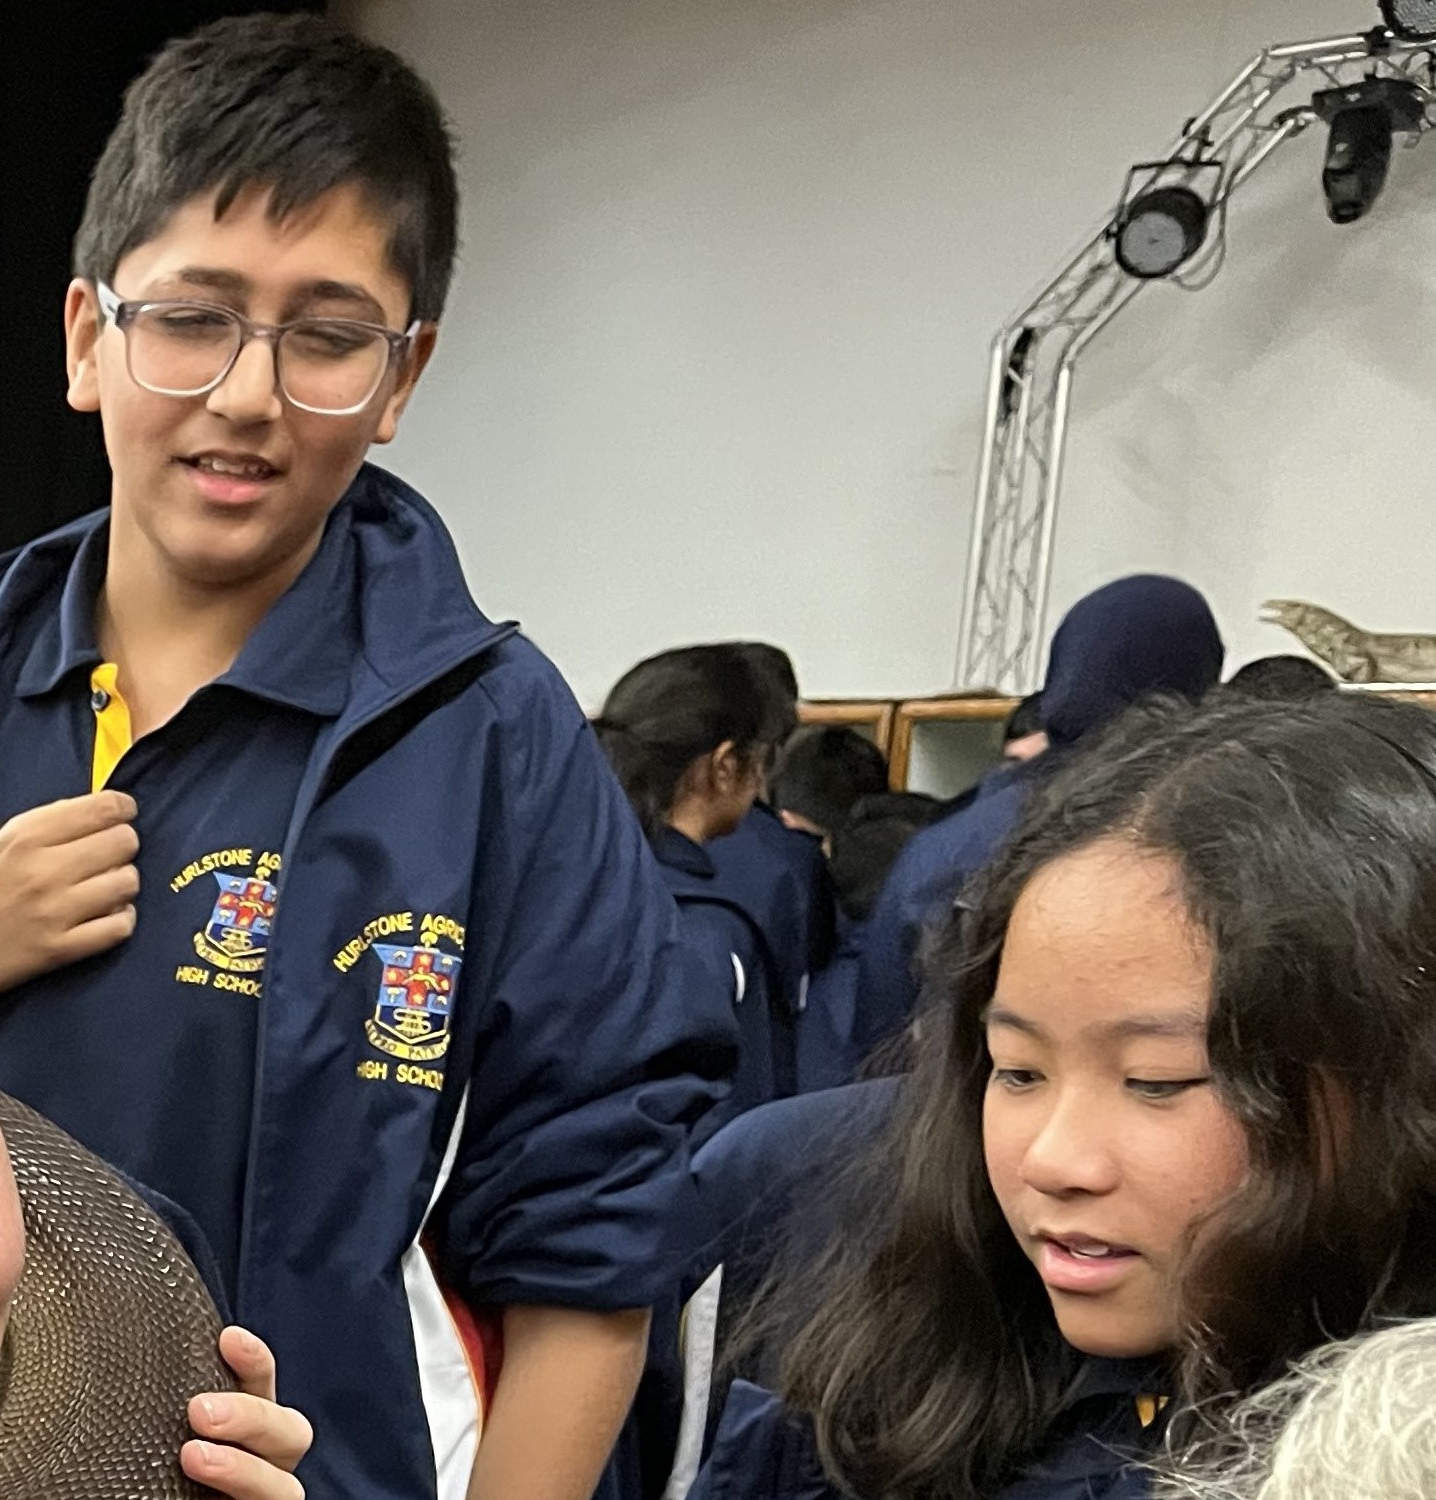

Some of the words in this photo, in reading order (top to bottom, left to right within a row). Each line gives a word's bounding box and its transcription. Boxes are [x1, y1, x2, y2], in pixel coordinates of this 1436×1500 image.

[170, 849, 252, 893] HURLSTONE
[332, 911, 414, 973] HURLSTONE
[175, 965, 209, 986] HIGH
